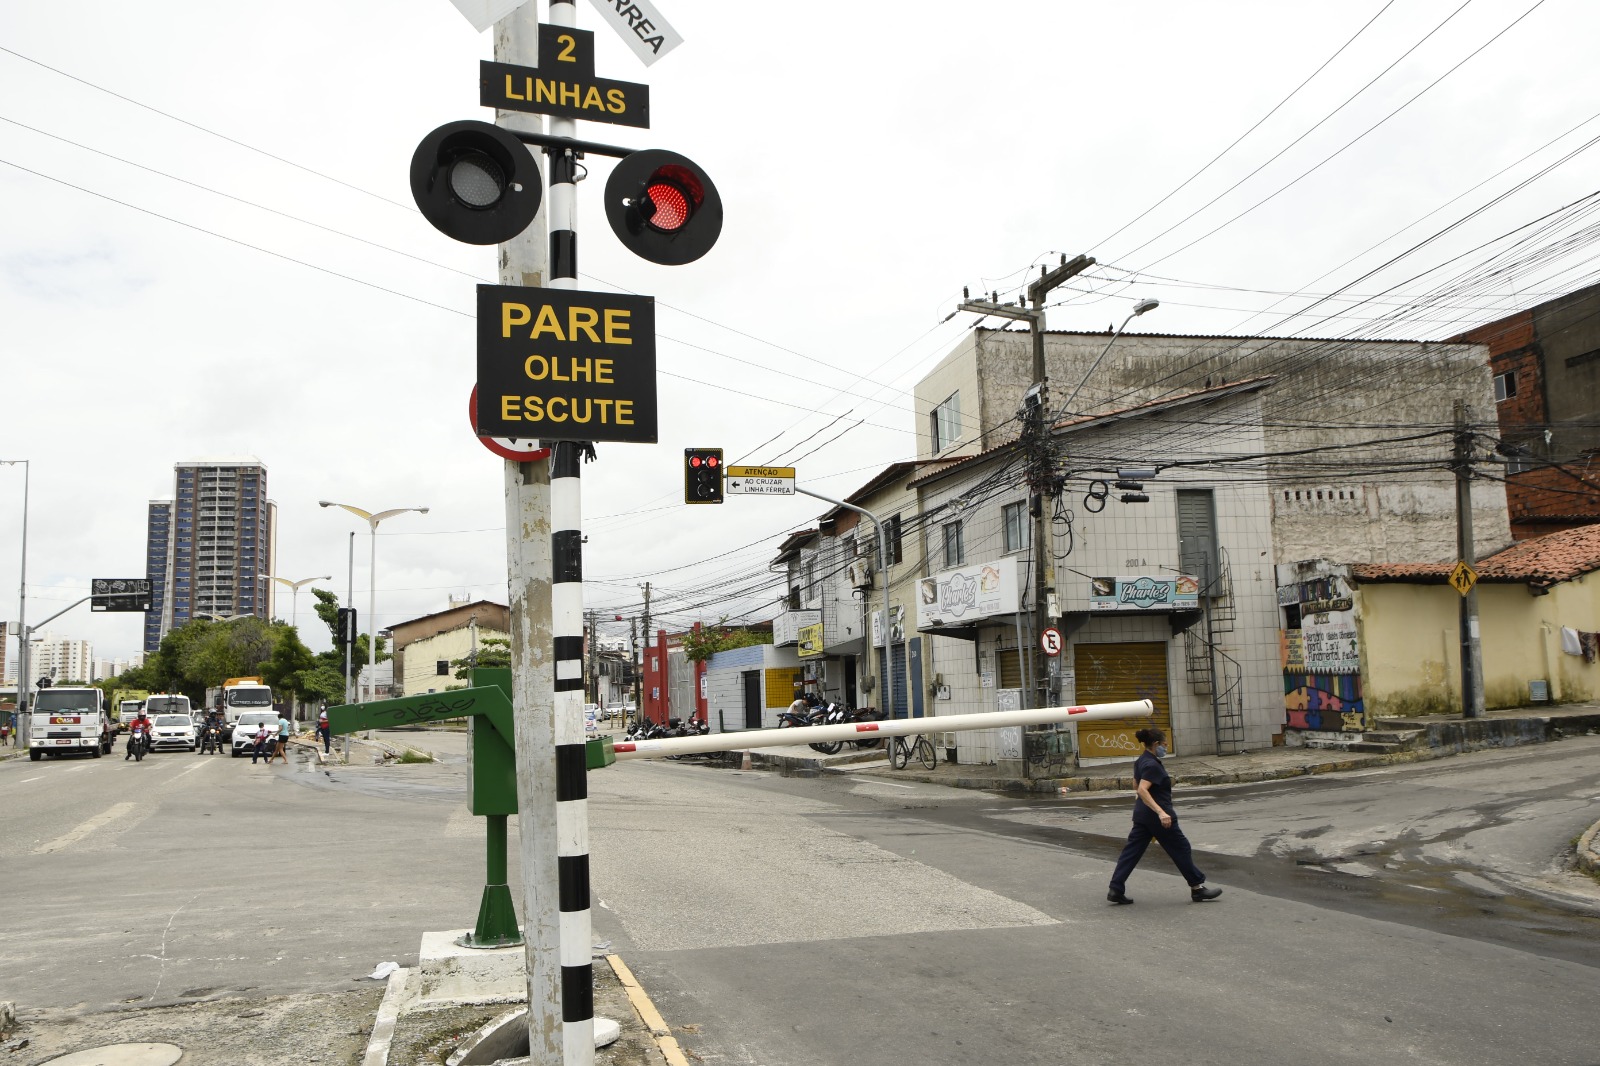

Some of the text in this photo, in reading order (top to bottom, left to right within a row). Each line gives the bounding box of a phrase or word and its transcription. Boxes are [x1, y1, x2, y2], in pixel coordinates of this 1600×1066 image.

[607, 0, 665, 55] RREA
[557, 34, 576, 62] 2
[505, 74, 626, 114] LINHAS
[501, 302, 633, 345] PARE
[524, 354, 615, 384] OLHE
[501, 394, 635, 425] ESCUTE
[755, 478, 783, 486] CRUZAR
[1125, 558, 1138, 568] 200
[1048, 634, 1056, 649] E
